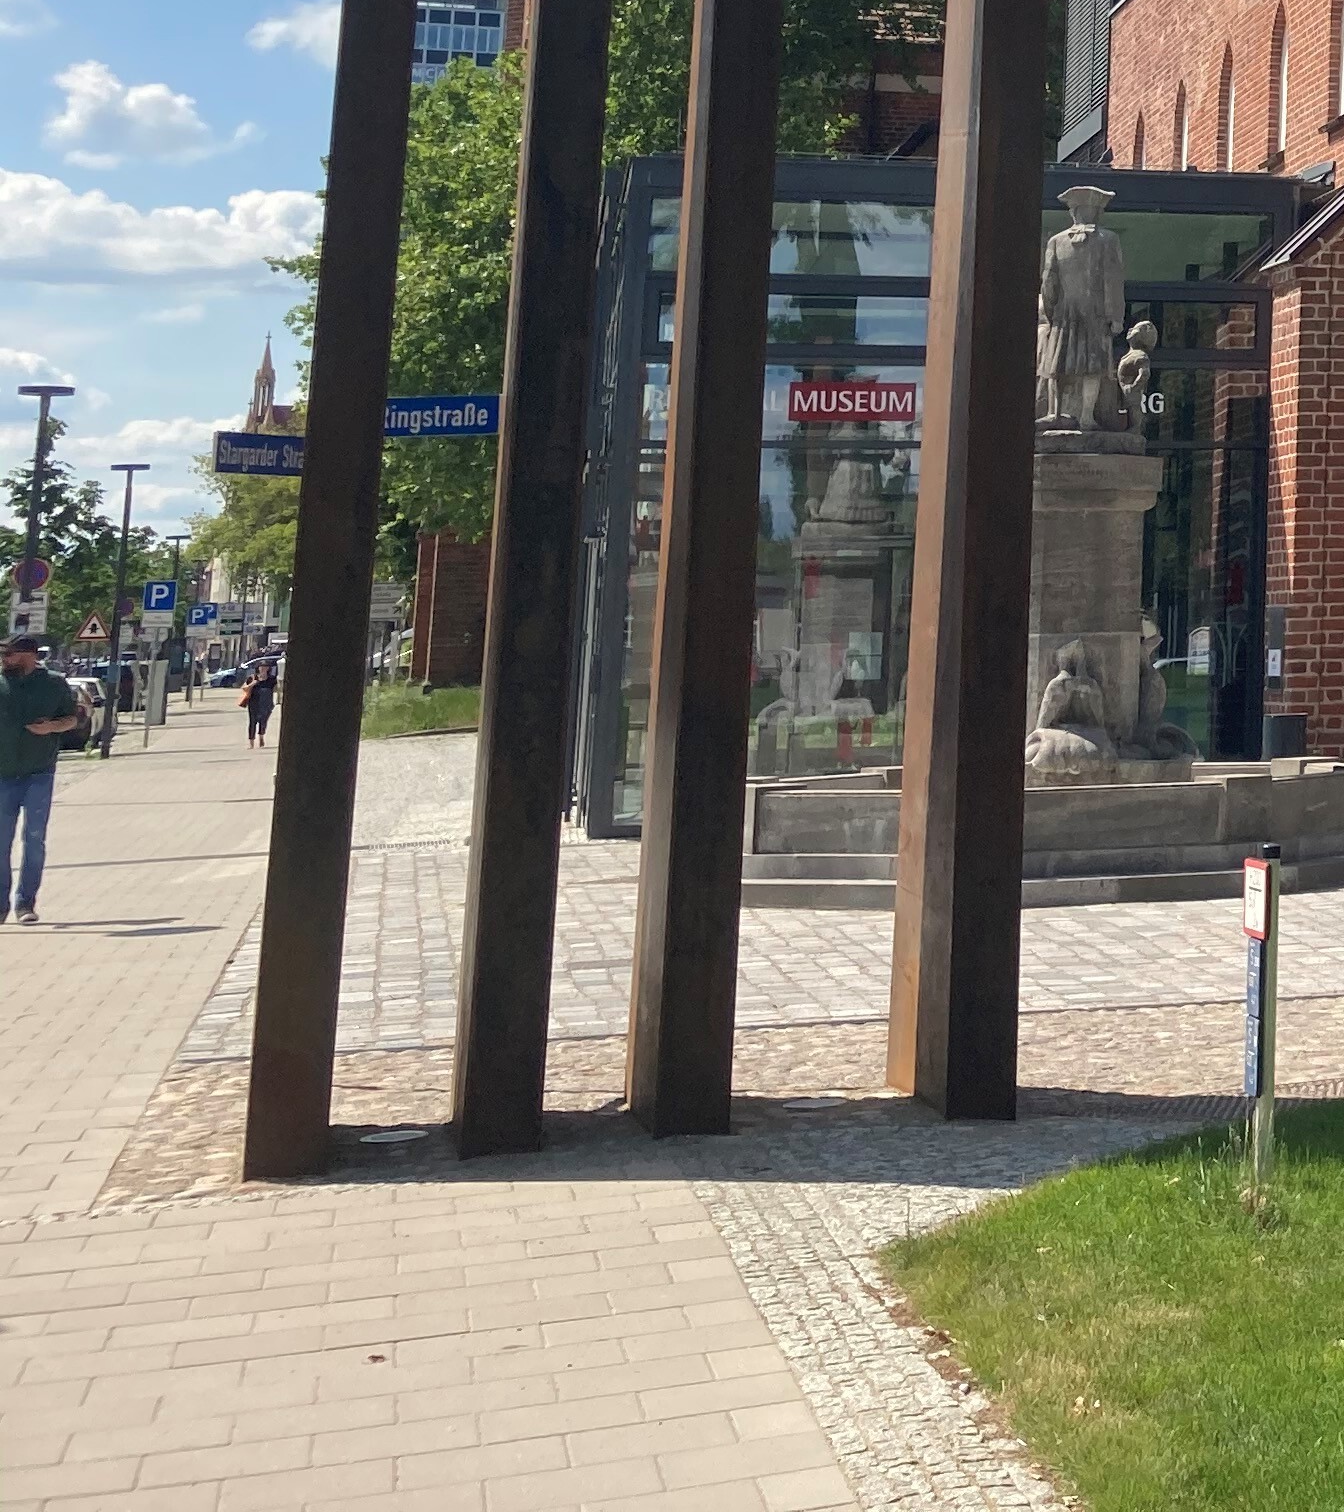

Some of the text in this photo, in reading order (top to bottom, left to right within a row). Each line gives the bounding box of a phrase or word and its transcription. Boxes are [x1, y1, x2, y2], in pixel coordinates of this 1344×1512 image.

[794, 390, 912, 413] MUSEUM
[219, 439, 278, 472] Stargarder
[151, 584, 169, 608] P
